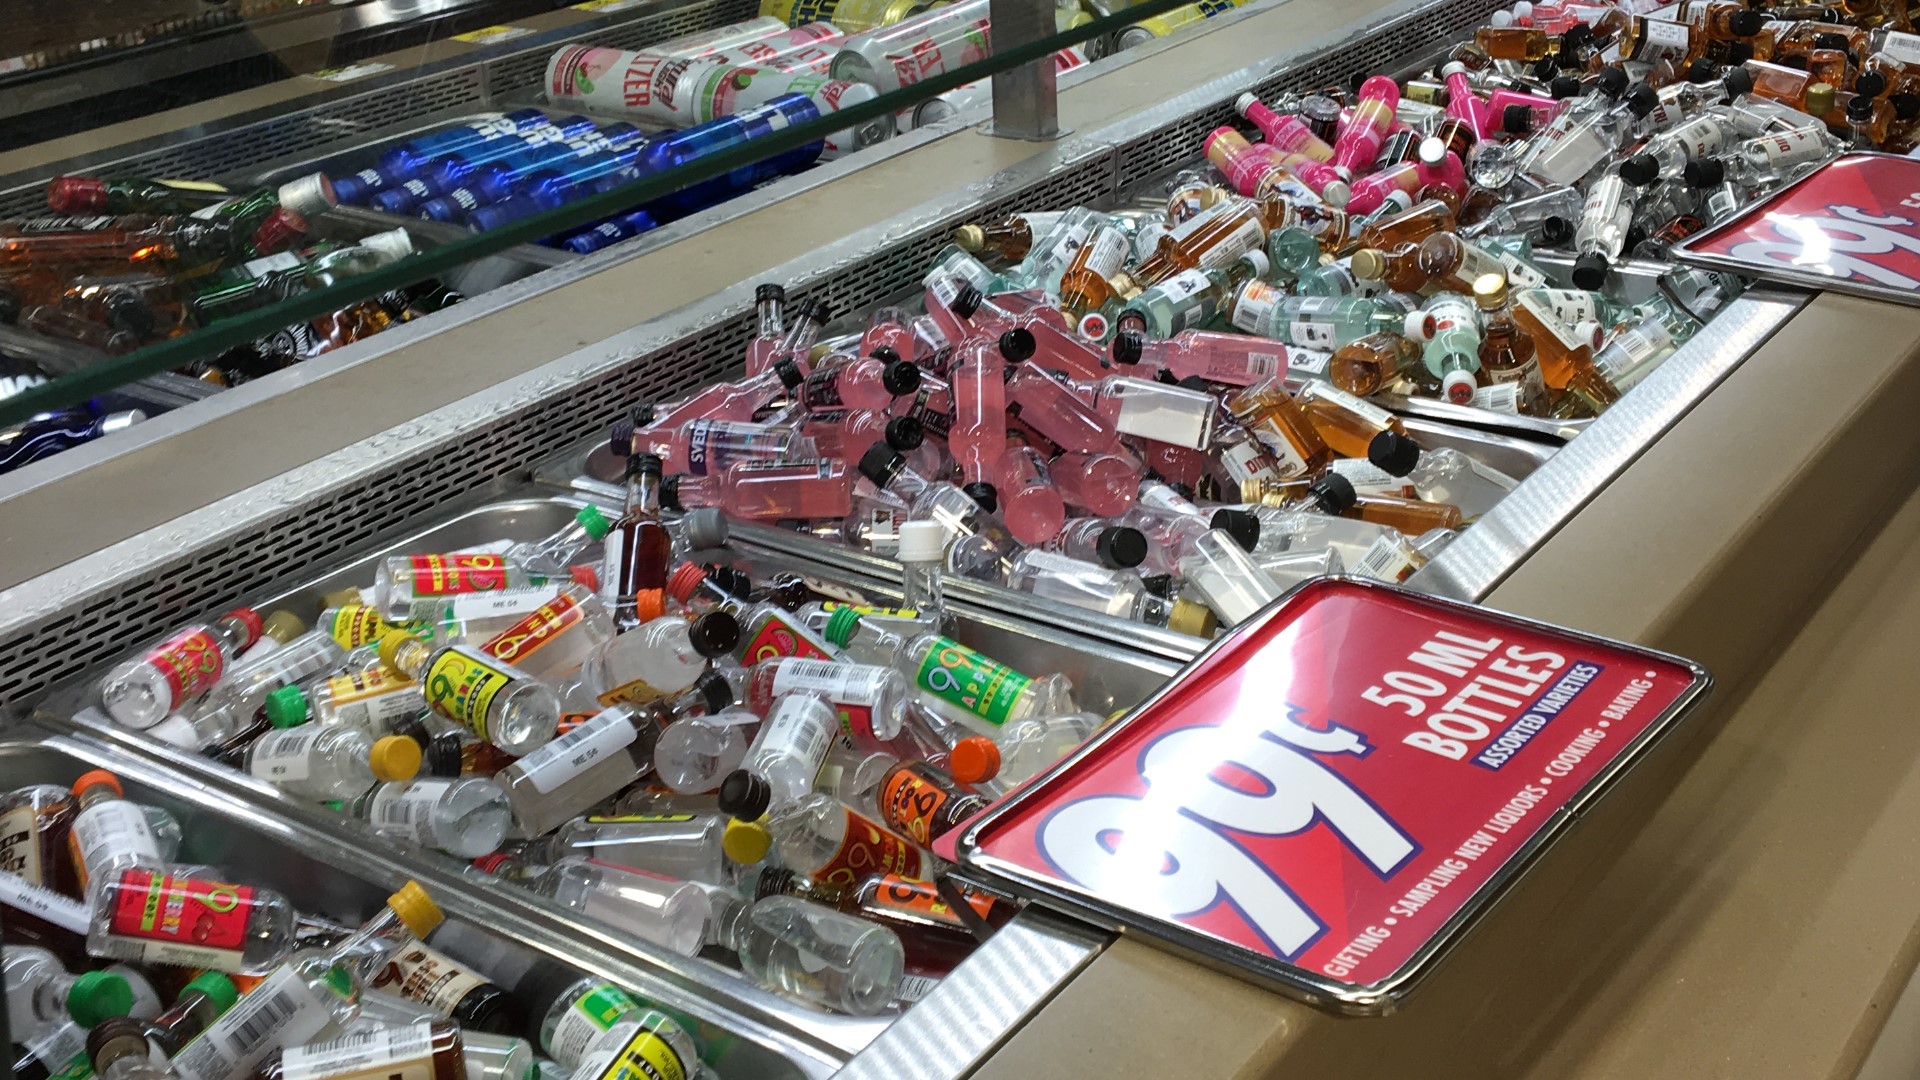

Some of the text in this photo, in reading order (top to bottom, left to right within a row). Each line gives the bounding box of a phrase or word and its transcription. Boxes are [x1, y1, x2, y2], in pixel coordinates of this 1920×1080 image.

[929, 650, 972, 690] 99
[1361, 630, 1503, 717] 50 ML
[1402, 645, 1566, 761] BOTTLES
[1478, 664, 1599, 769] ASSORTED VARIETIES
[1323, 678, 1654, 977] GIFTING SAMPLING NEW LIQUORS COOKING BAKING
